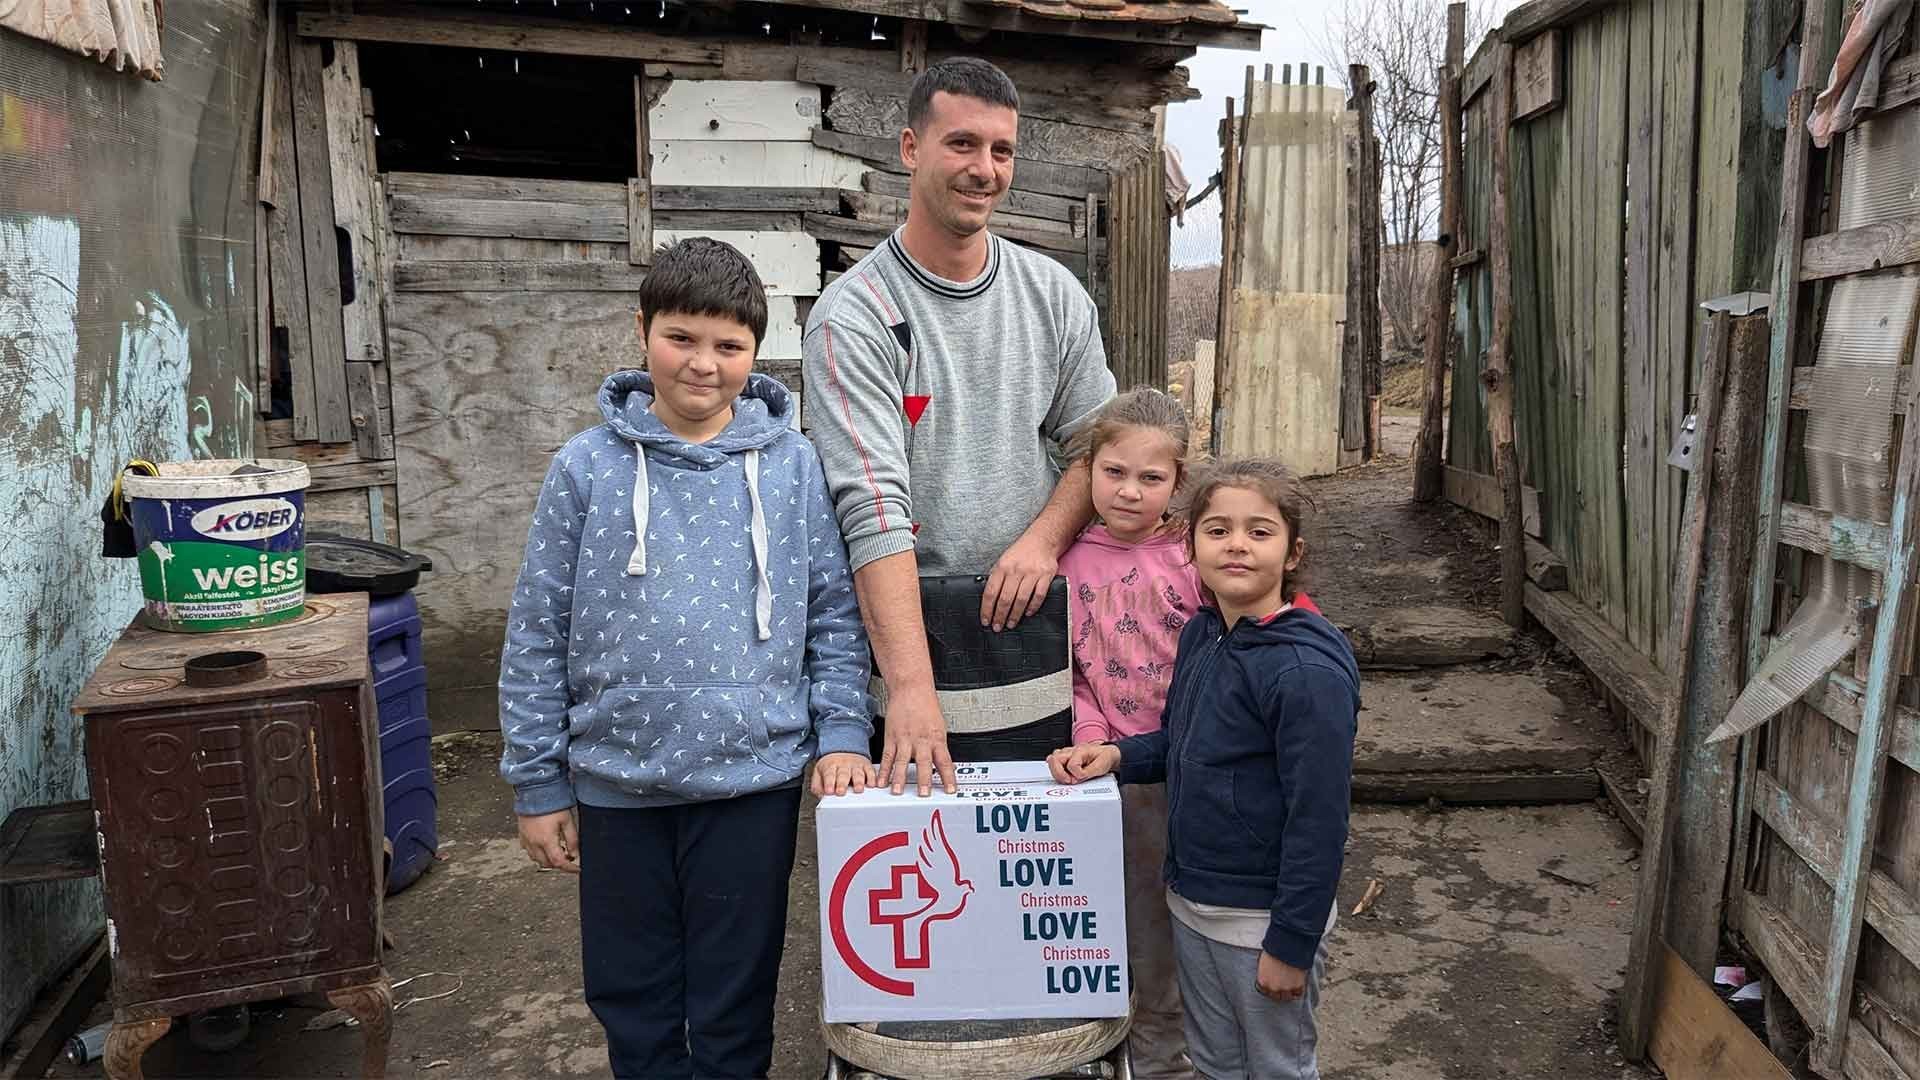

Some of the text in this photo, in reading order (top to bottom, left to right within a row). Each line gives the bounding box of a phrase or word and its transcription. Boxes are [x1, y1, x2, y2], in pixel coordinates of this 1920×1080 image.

[204, 509, 291, 533] KÖBER
[192, 554, 298, 590] weiss
[956, 790, 1028, 798] LOVE
[976, 804, 1049, 833] LOVE
[999, 839, 1064, 853] Christmas
[1000, 858, 1073, 887] LOVE
[1022, 892, 1088, 907] Christmas
[1023, 912, 1096, 940] LOVE
[1044, 946, 1110, 960] Christmas
[1047, 965, 1120, 993] LOVE
